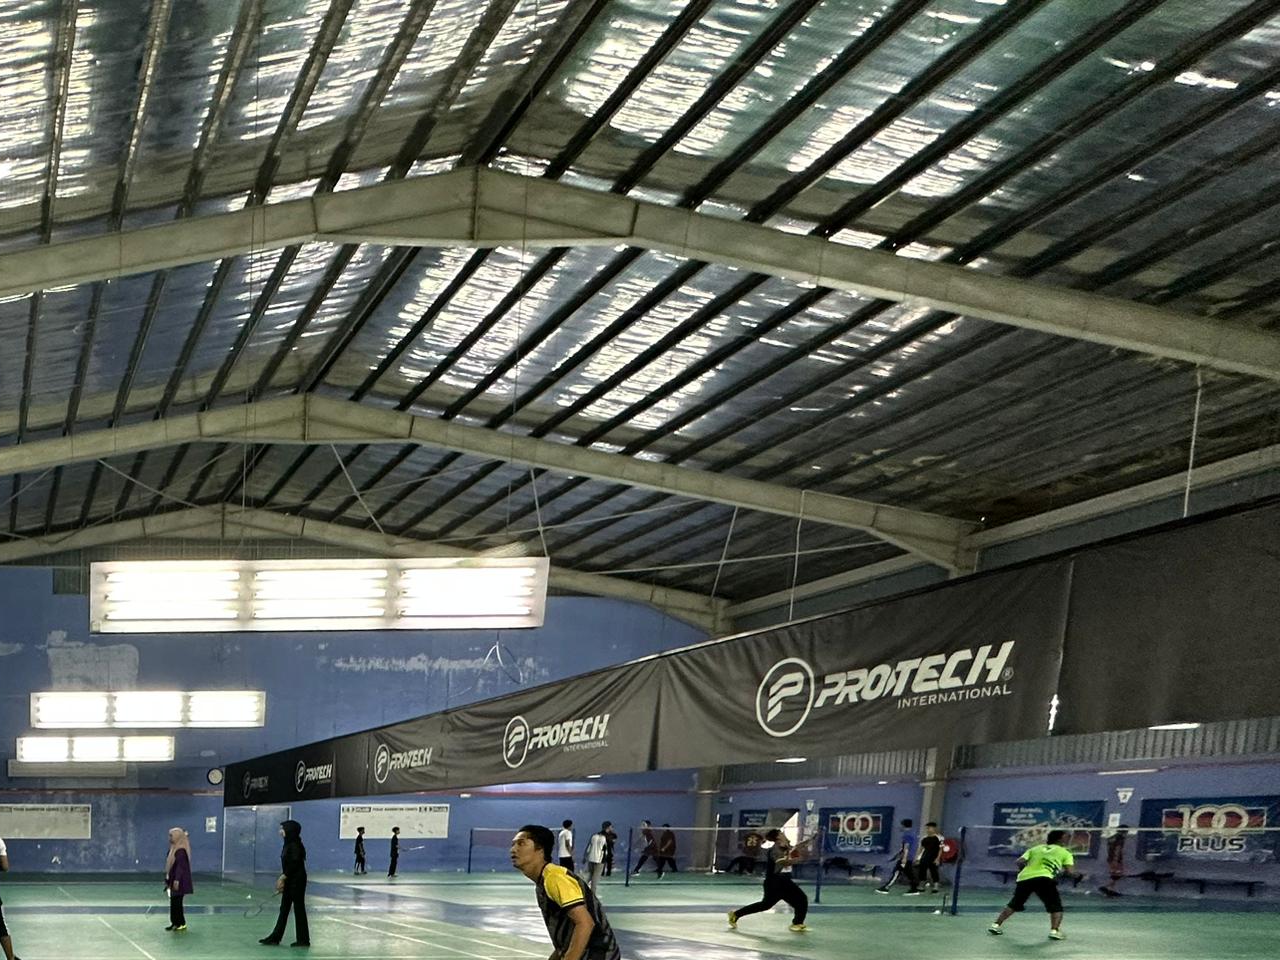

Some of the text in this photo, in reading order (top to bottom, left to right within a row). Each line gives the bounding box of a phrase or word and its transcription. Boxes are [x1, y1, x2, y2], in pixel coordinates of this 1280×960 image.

[897, 684, 1012, 709] INTERNATIONAL
[528, 714, 610, 750] PROTECH
[563, 740, 609, 753] INTERNATIONAL
[836, 812, 873, 836] 100
[1177, 804, 1249, 836] 100
[836, 836, 873, 847] PLUS
[1177, 836, 1248, 853] PLUS
